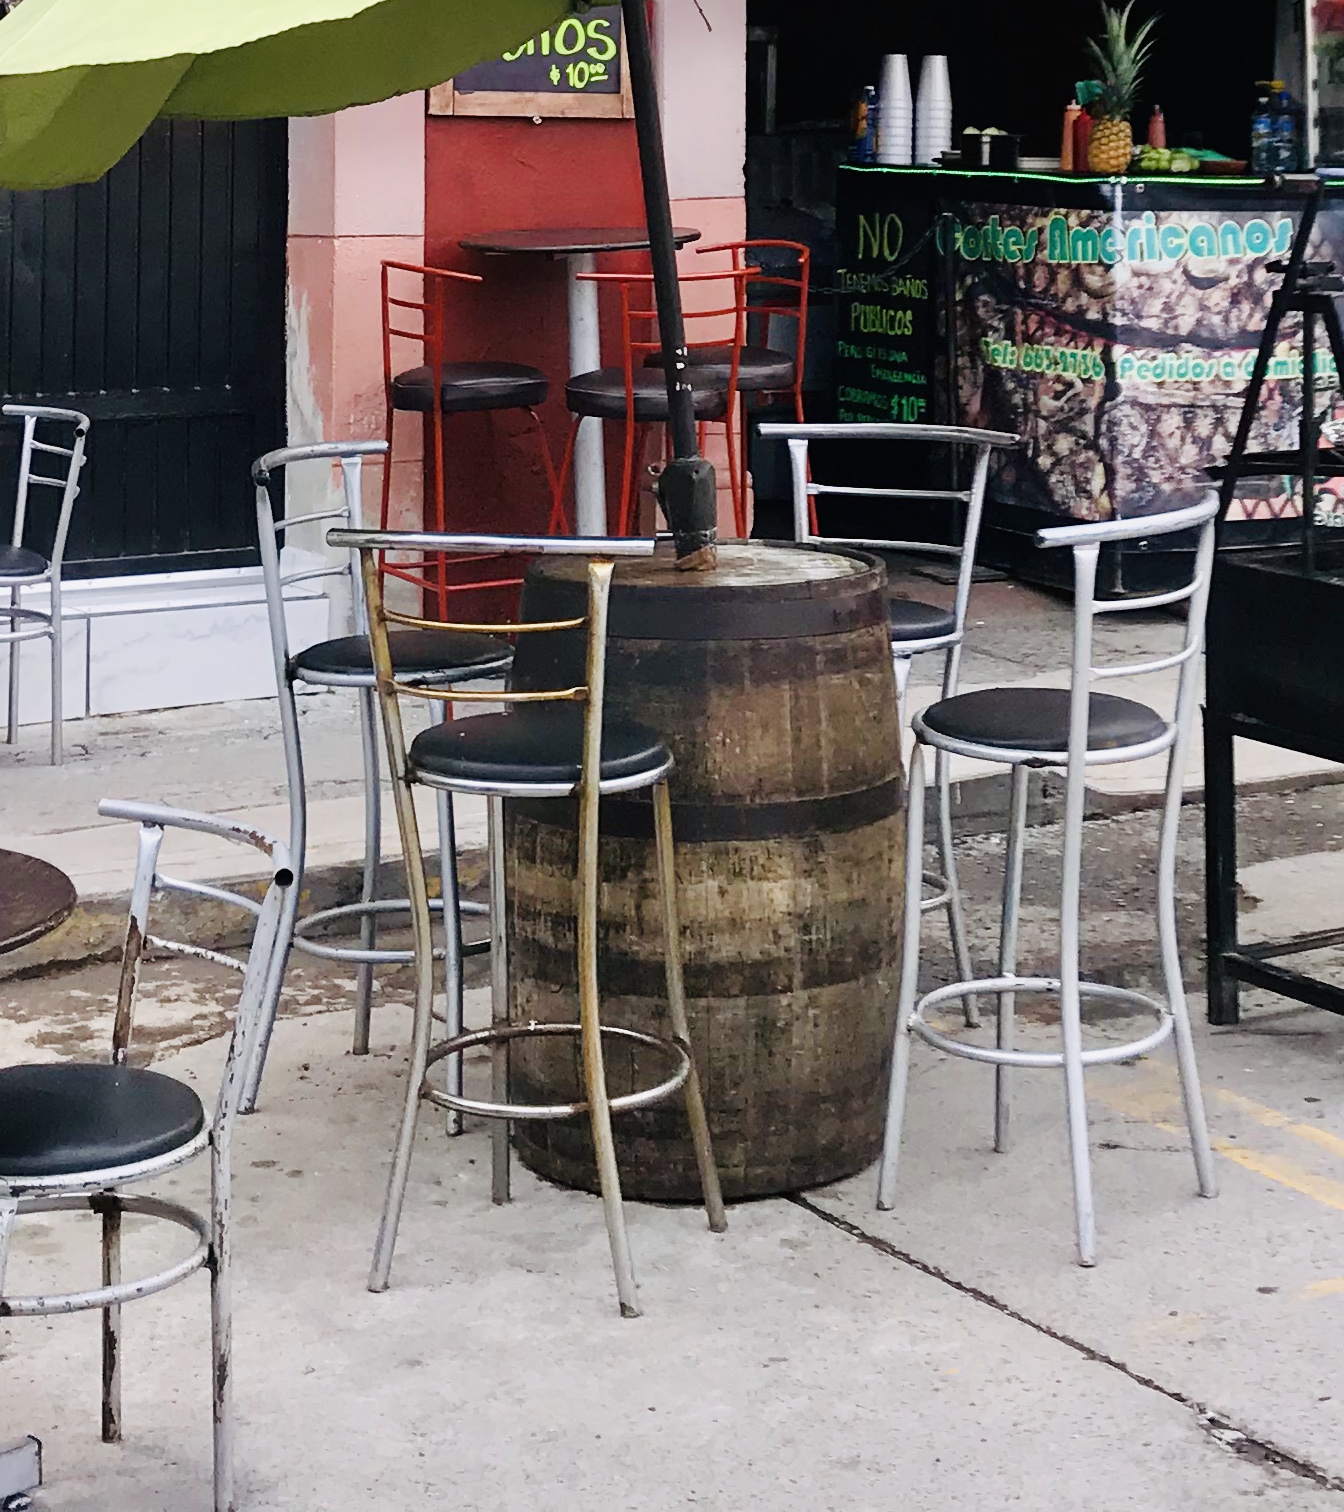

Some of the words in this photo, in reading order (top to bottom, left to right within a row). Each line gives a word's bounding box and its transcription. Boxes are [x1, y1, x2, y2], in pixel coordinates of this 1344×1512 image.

[858, 212, 904, 263] NO
[1047, 209, 1294, 264] Americanos
[890, 274, 928, 300] BAÑOS
[851, 301, 913, 336] PUBLICOS
[1115, 353, 1217, 382] Pedidos
[1219, 359, 1238, 380] a
